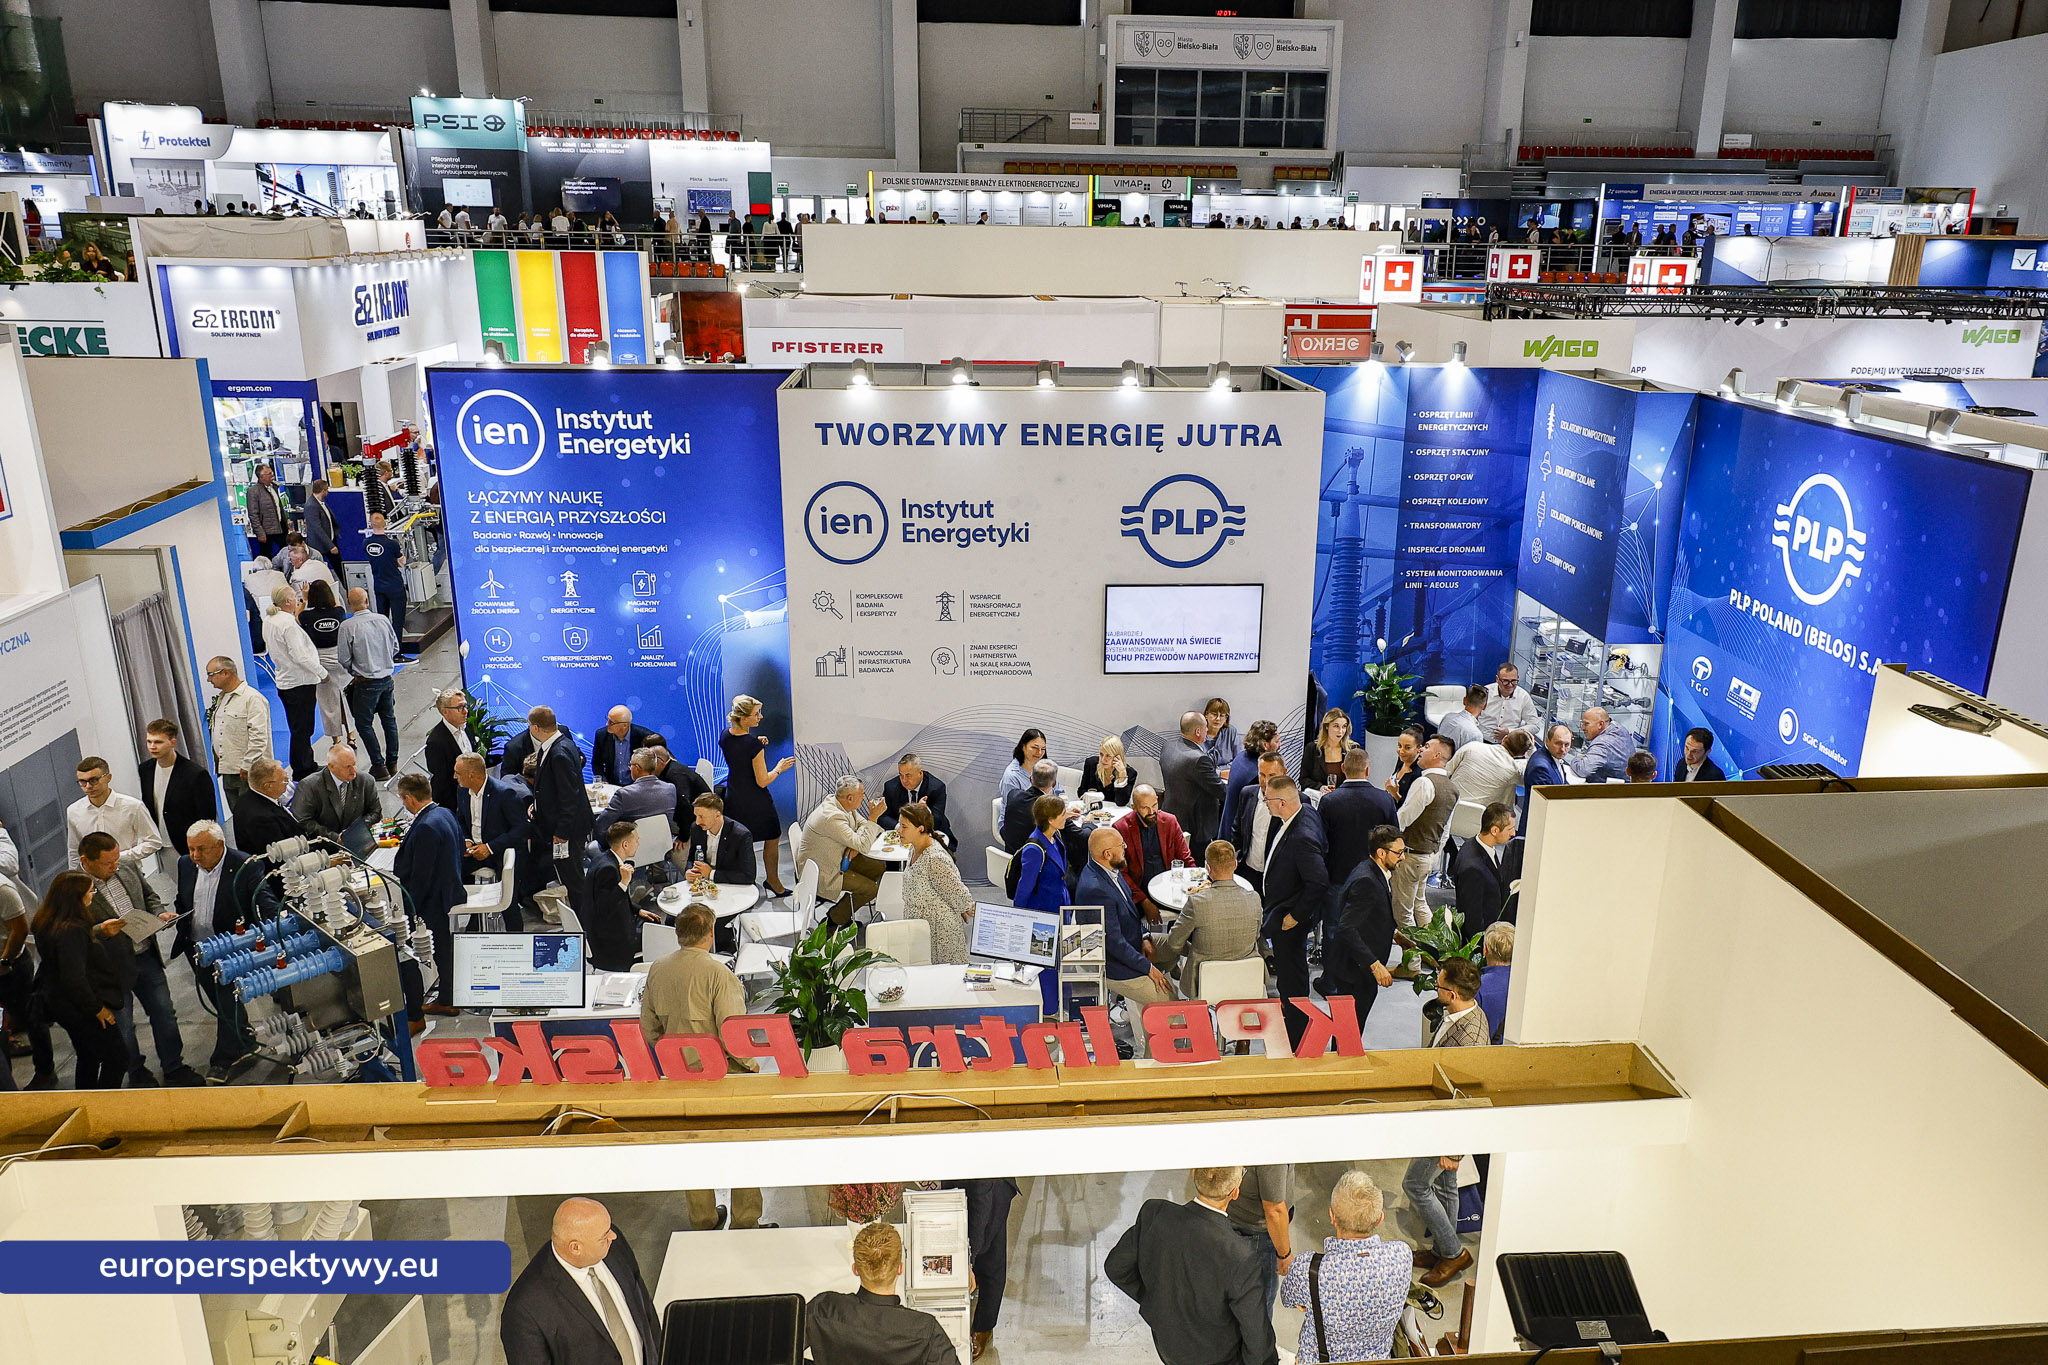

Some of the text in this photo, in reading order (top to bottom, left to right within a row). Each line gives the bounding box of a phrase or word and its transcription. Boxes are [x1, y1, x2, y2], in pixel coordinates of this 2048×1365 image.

[1177, 42, 1219, 51] Bielsko-Biała
[1276, 44, 1317, 52] Bielsko-Biała
[423, 114, 478, 130] PSI
[158, 136, 211, 147] Protektel
[911, 178, 969, 186] STOWARZYSZENIE
[970, 177, 997, 187] BRANŻY
[998, 179, 1080, 188] ELEKTROENERGETYCZNEJ
[1113, 180, 1143, 188] VIMAP
[372, 280, 409, 322] ERGOM
[221, 309, 276, 329] ERGOM
[1961, 325, 2021, 348] WAGO
[771, 341, 884, 354] PFISTERER
[1523, 334, 1598, 362] WAGO
[1630, 366, 1647, 374] APP
[1850, 367, 1887, 376] PODEJMIJ
[1888, 367, 1931, 375] WYZWANIE
[1971, 367, 1985, 375] IEK
[227, 384, 272, 393] ergom.com
[555, 407, 653, 434] Instytut
[1419, 411, 1474, 420] OSPRZĘT LINII
[472, 414, 529, 445] ien
[1417, 423, 1489, 431] ENERGETYCZNYCH
[814, 422, 1282, 453] TWORZYMY ENERGIĘ JUTRA
[558, 432, 692, 460] Energetyki
[1415, 448, 1490, 458] OSPRZĘT STACYJNY
[1413, 473, 1474, 482] OSPRZĘT OPGW
[467, 490, 603, 507] ŁĄCZYMY NAUKĘ
[1411, 498, 1446, 507] OSPRZĘT
[901, 497, 994, 523] Instytut
[470, 508, 667, 526] Z ENERGIĄ PRZYSZŁOŚCI
[820, 506, 873, 535] ien
[1151, 508, 1219, 535] PLP
[1409, 522, 1482, 530] TRANSFORMATORY
[473, 531, 604, 541] Badania Rozwój Innowacje
[901, 521, 1030, 548] Energetyki
[1791, 515, 1844, 564] PLP
[474, 544, 668, 555] dla bezpiecznej zrównoważonej energetyki
[1407, 546, 1448, 554] INSPEKCJE
[1436, 569, 1504, 577] MONITOROWANIA
[1429, 581, 1460, 589] AEOLUS
[1728, 588, 1751, 612] PLP
[1751, 598, 1803, 638] POLAND
[1804, 624, 1858, 669] (BELOS)
[1106, 638, 1175, 646] ZAAWANSOWANY
[1190, 636, 1222, 645] ŚWIECIE
[488, 654, 514, 662] WODÓR
[1105, 651, 1260, 662] RUCHU PRZEWODÓW NAPOWIETRZNYCH
[1690, 679, 1710, 697] TGG
[1802, 732, 1848, 767] SGIC Insulator
